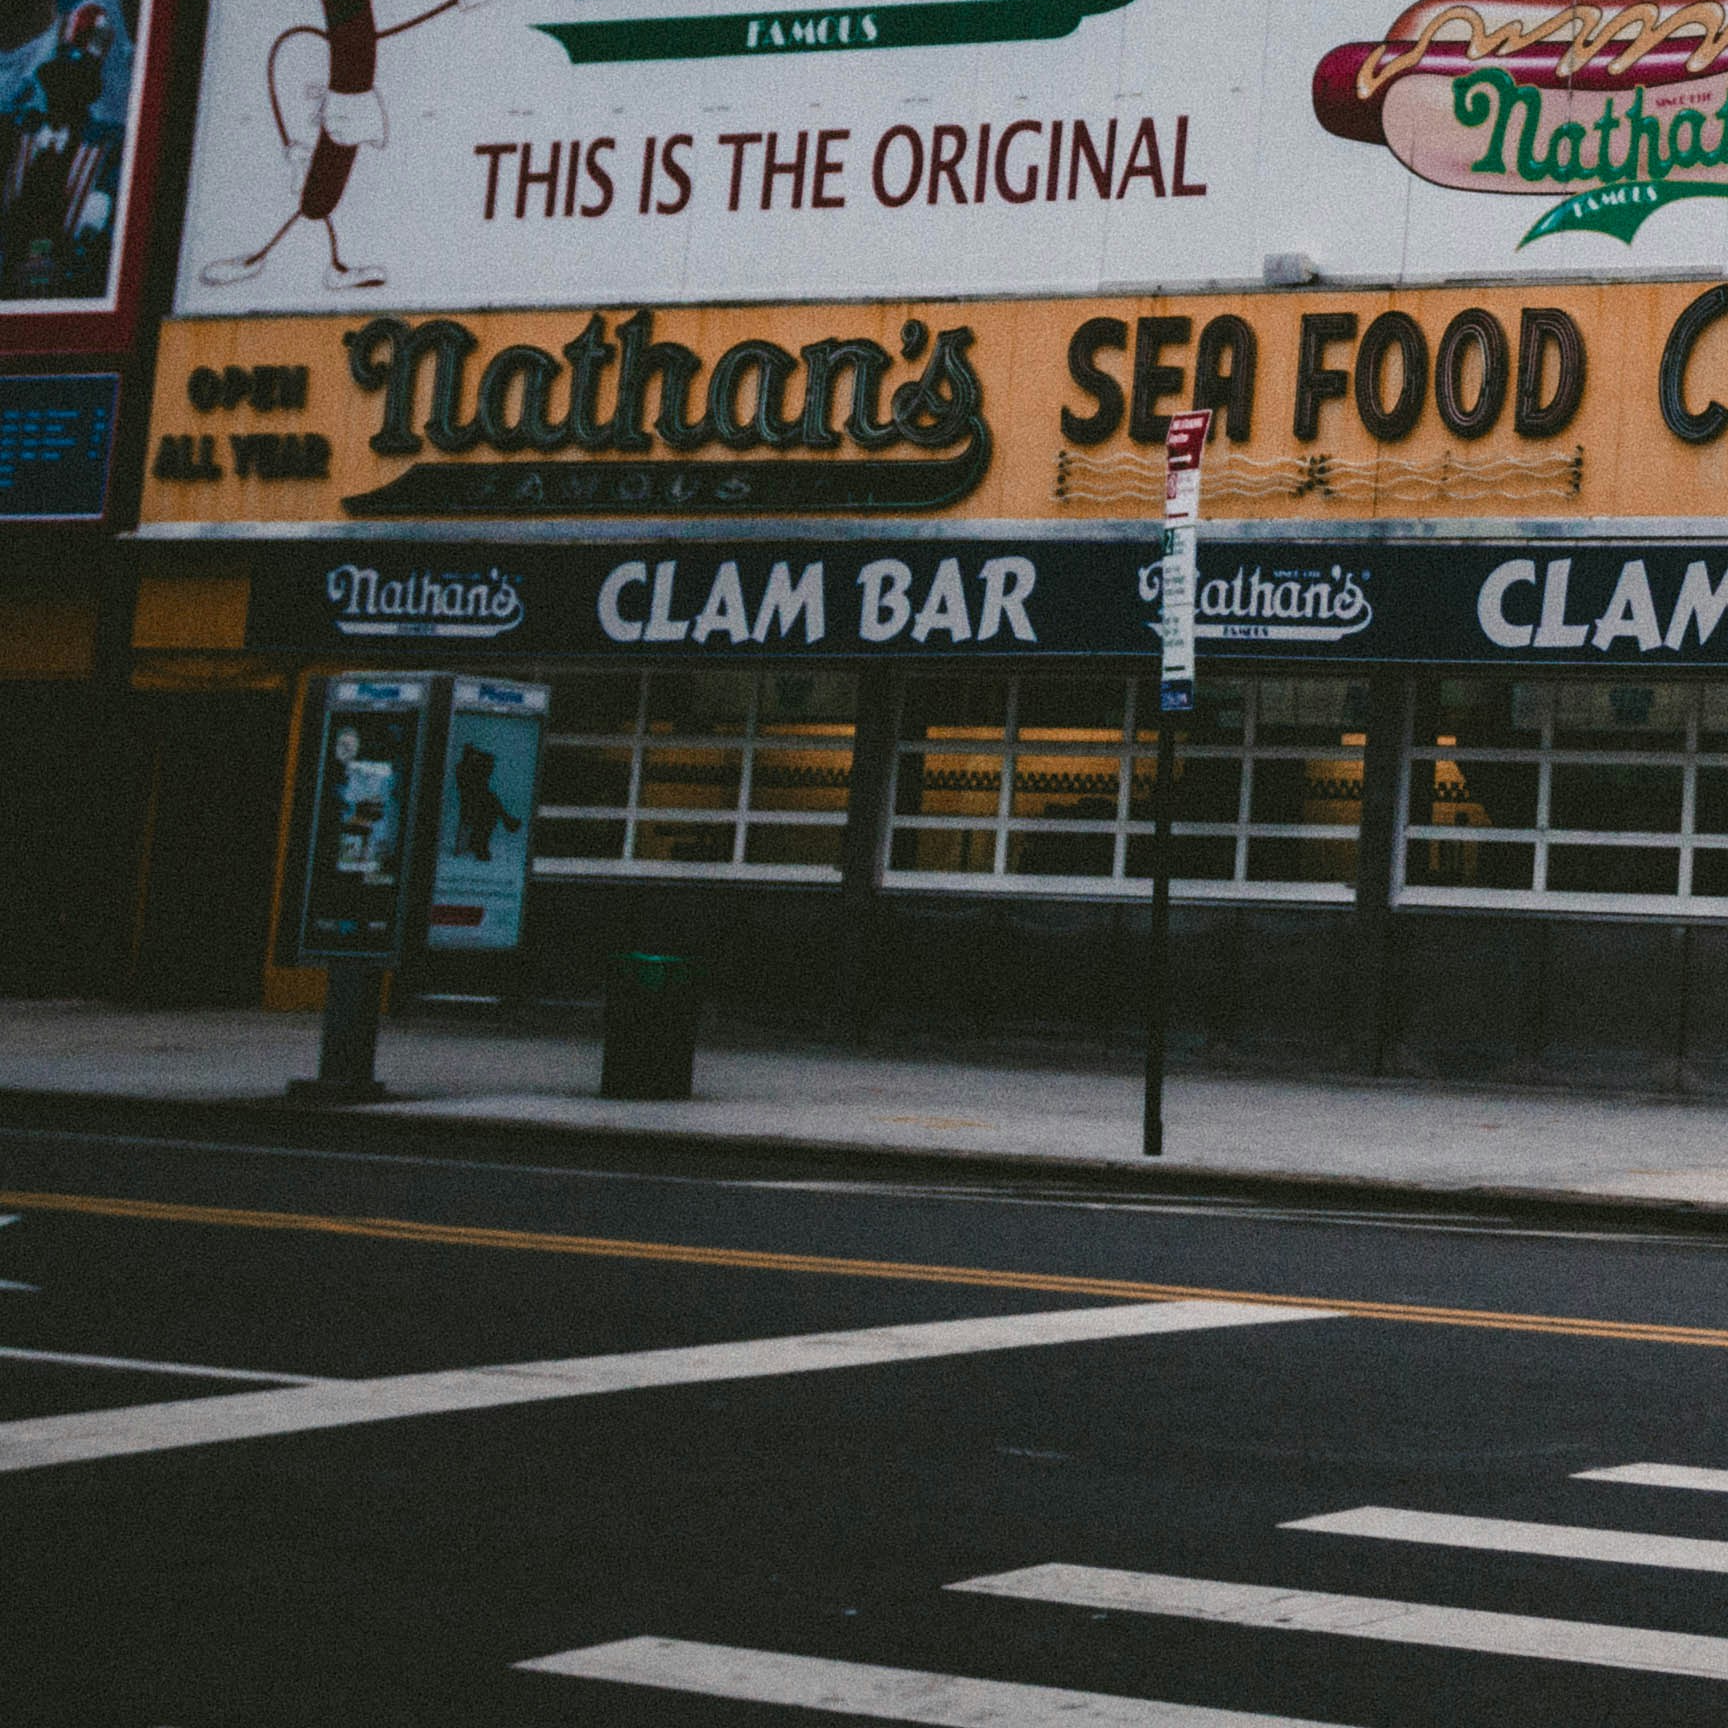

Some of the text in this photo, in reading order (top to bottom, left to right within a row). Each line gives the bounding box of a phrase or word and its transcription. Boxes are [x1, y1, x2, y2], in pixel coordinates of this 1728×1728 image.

[745, 12, 879, 49] FAMOUS
[473, 112, 1208, 220] THIS IS THE ORIGINAL
[186, 364, 310, 416] OPEN
[343, 309, 986, 461] Nathan's
[1058, 306, 1590, 446] SEA FOOD
[152, 431, 335, 481] ALL YEAR
[596, 555, 1039, 645] CLAM BAR
